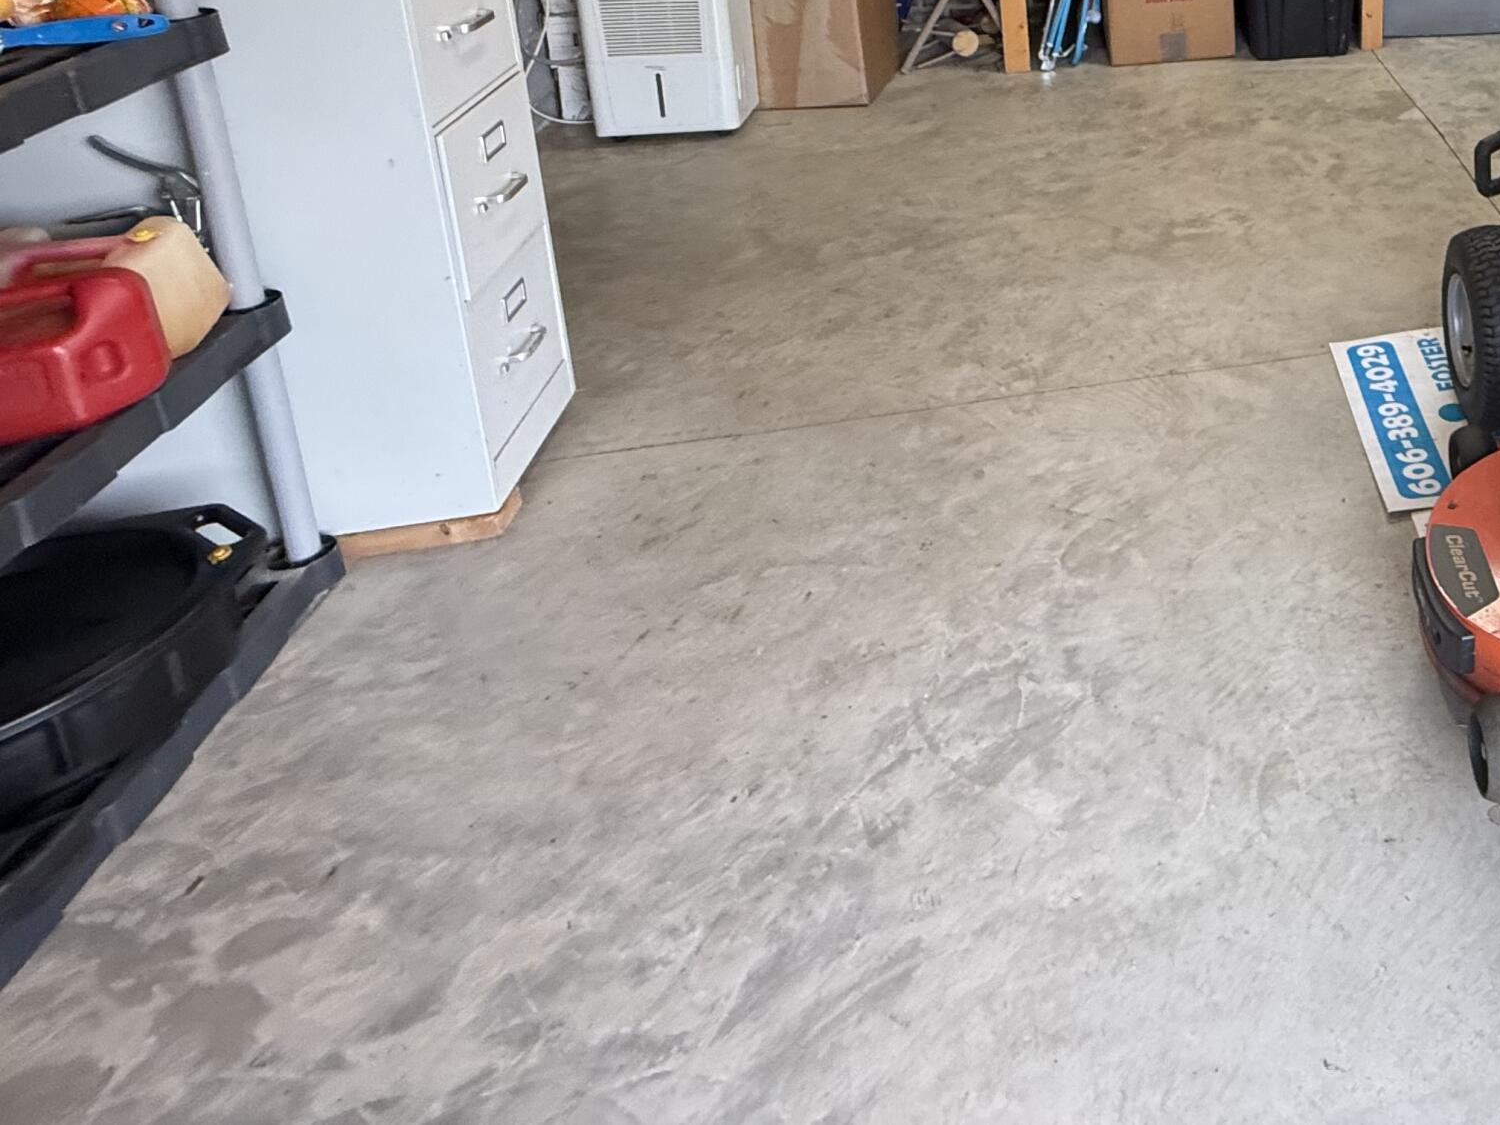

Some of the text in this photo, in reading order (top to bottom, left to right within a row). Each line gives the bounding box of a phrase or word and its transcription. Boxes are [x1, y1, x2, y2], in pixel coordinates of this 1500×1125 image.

[1417, 337, 1455, 392] FOSTER
[1356, 344, 1442, 496] 606-389-4029
[1445, 534, 1479, 600] ClearCut
